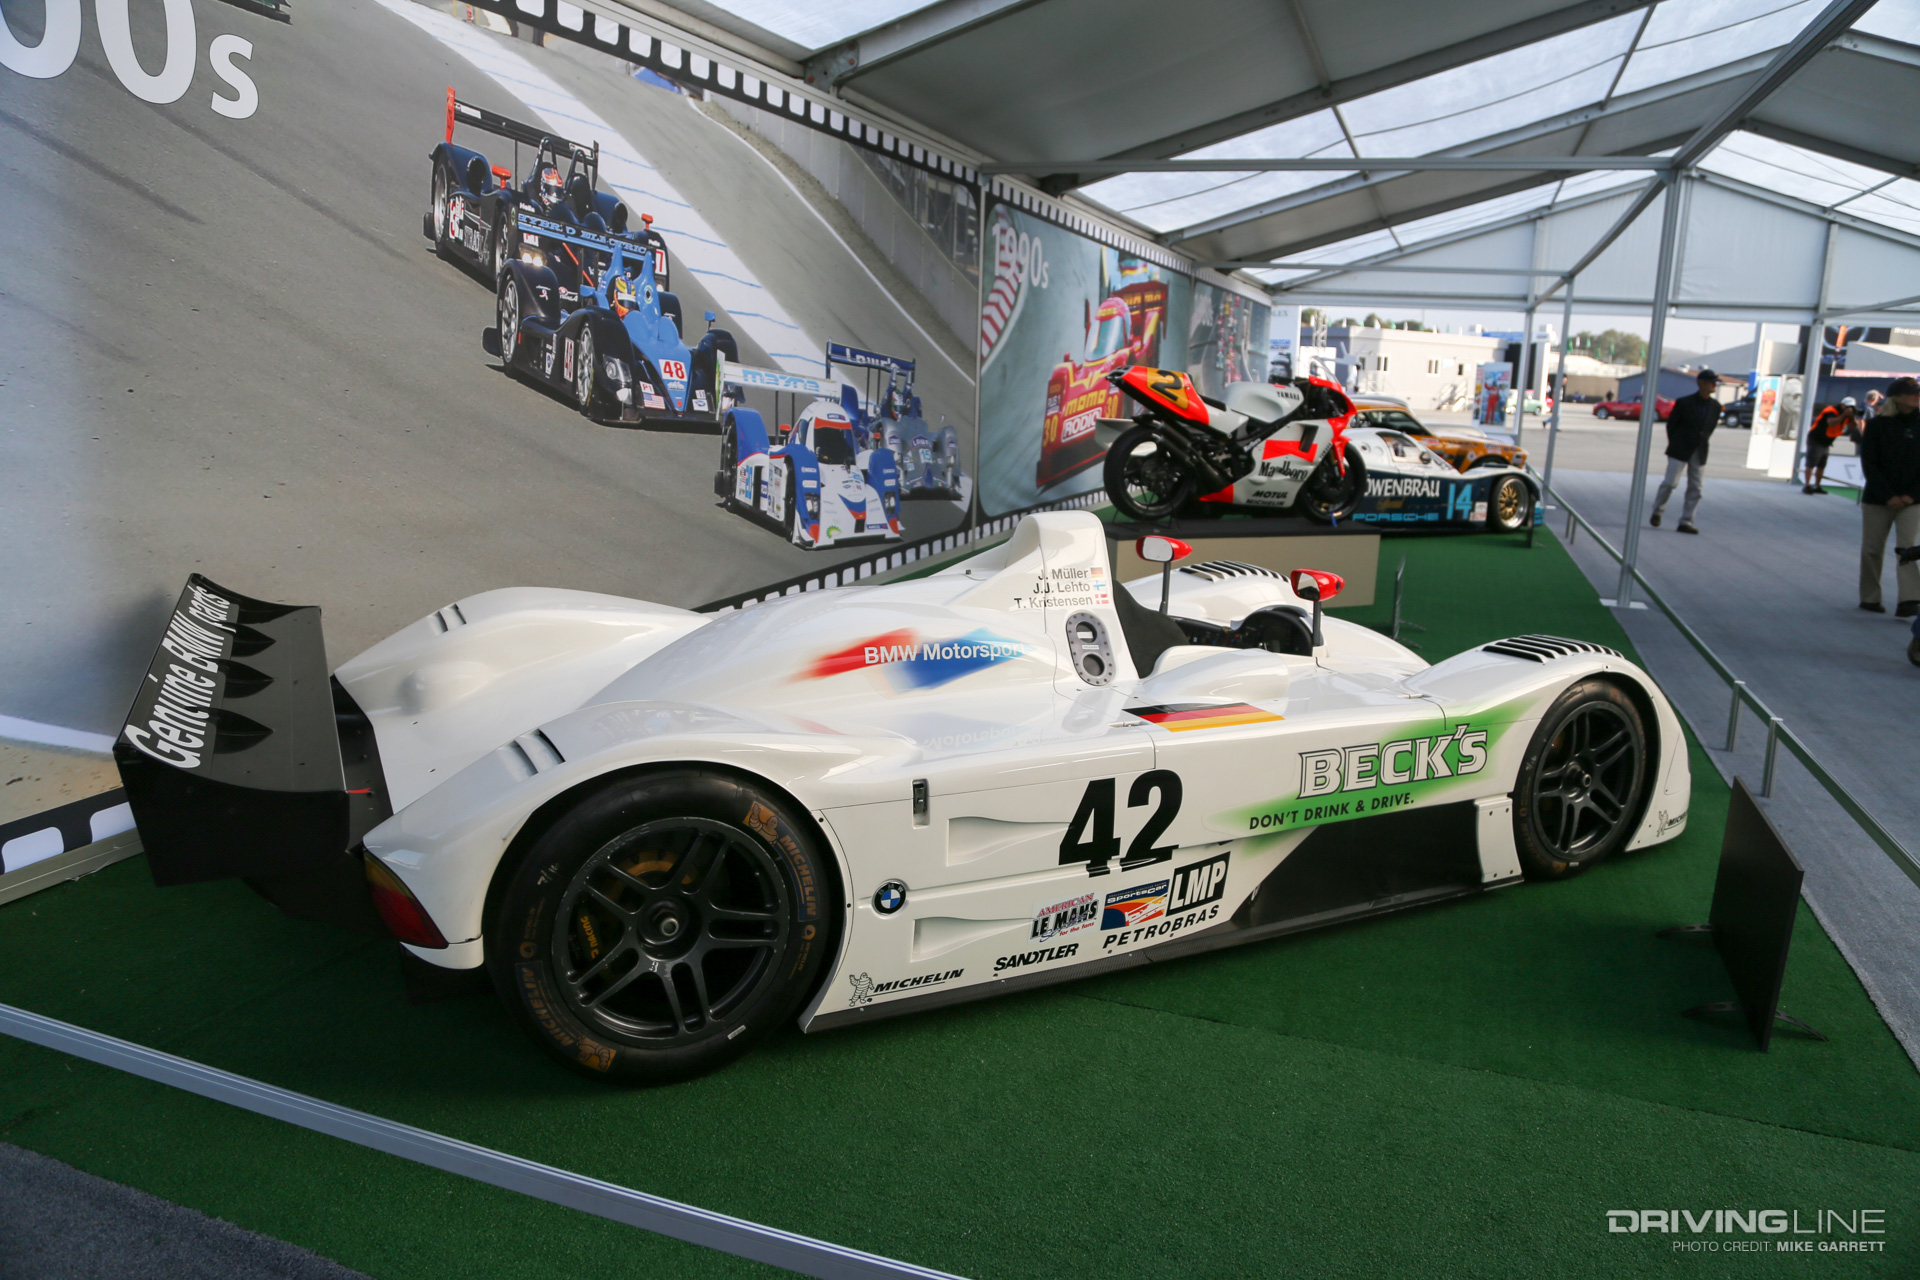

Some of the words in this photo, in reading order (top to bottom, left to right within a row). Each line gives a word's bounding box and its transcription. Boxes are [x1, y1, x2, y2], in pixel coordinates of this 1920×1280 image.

[518, 213, 576, 236] HYBRD
[992, 222, 1049, 289] 1990s
[663, 360, 685, 380] 48
[1150, 370, 1182, 402] 2
[920, 449, 932, 461] 15
[1258, 461, 1308, 480] Marlboro
[1352, 513, 1439, 522] PORSCHE
[1446, 483, 1473, 520] 14
[1033, 582, 1054, 594] J.J.
[1057, 581, 1090, 593] Lehto
[1038, 570, 1049, 580] J.
[1052, 568, 1088, 580] Müller
[187, 584, 237, 634] parts
[1014, 597, 1026, 609] T.
[1028, 596, 1094, 608] Kristensen
[162, 610, 225, 674] BMW
[864, 642, 918, 664] BMW
[922, 642, 1026, 661] Motorsport
[124, 663, 216, 769] Genuine
[1296, 723, 1488, 801] BECK'S
[1058, 768, 1184, 878] 42
[1250, 810, 1299, 830] DON'T
[1304, 800, 1350, 822] DRINK
[1355, 799, 1366, 812] &
[1371, 792, 1414, 811] DRIVE.
[779, 834, 817, 917] MICHELIN
[1170, 860, 1227, 911] LMP
[1030, 917, 1049, 940] LE
[1052, 899, 1100, 929] MANS
[1037, 892, 1094, 917] AMERICAN
[1082, 922, 1095, 930] fans
[1102, 904, 1220, 950] PETROBRAS
[993, 942, 1079, 972] SANDTLER
[874, 968, 964, 993] MICHELIN
[520, 966, 575, 1047] MICHELIN
